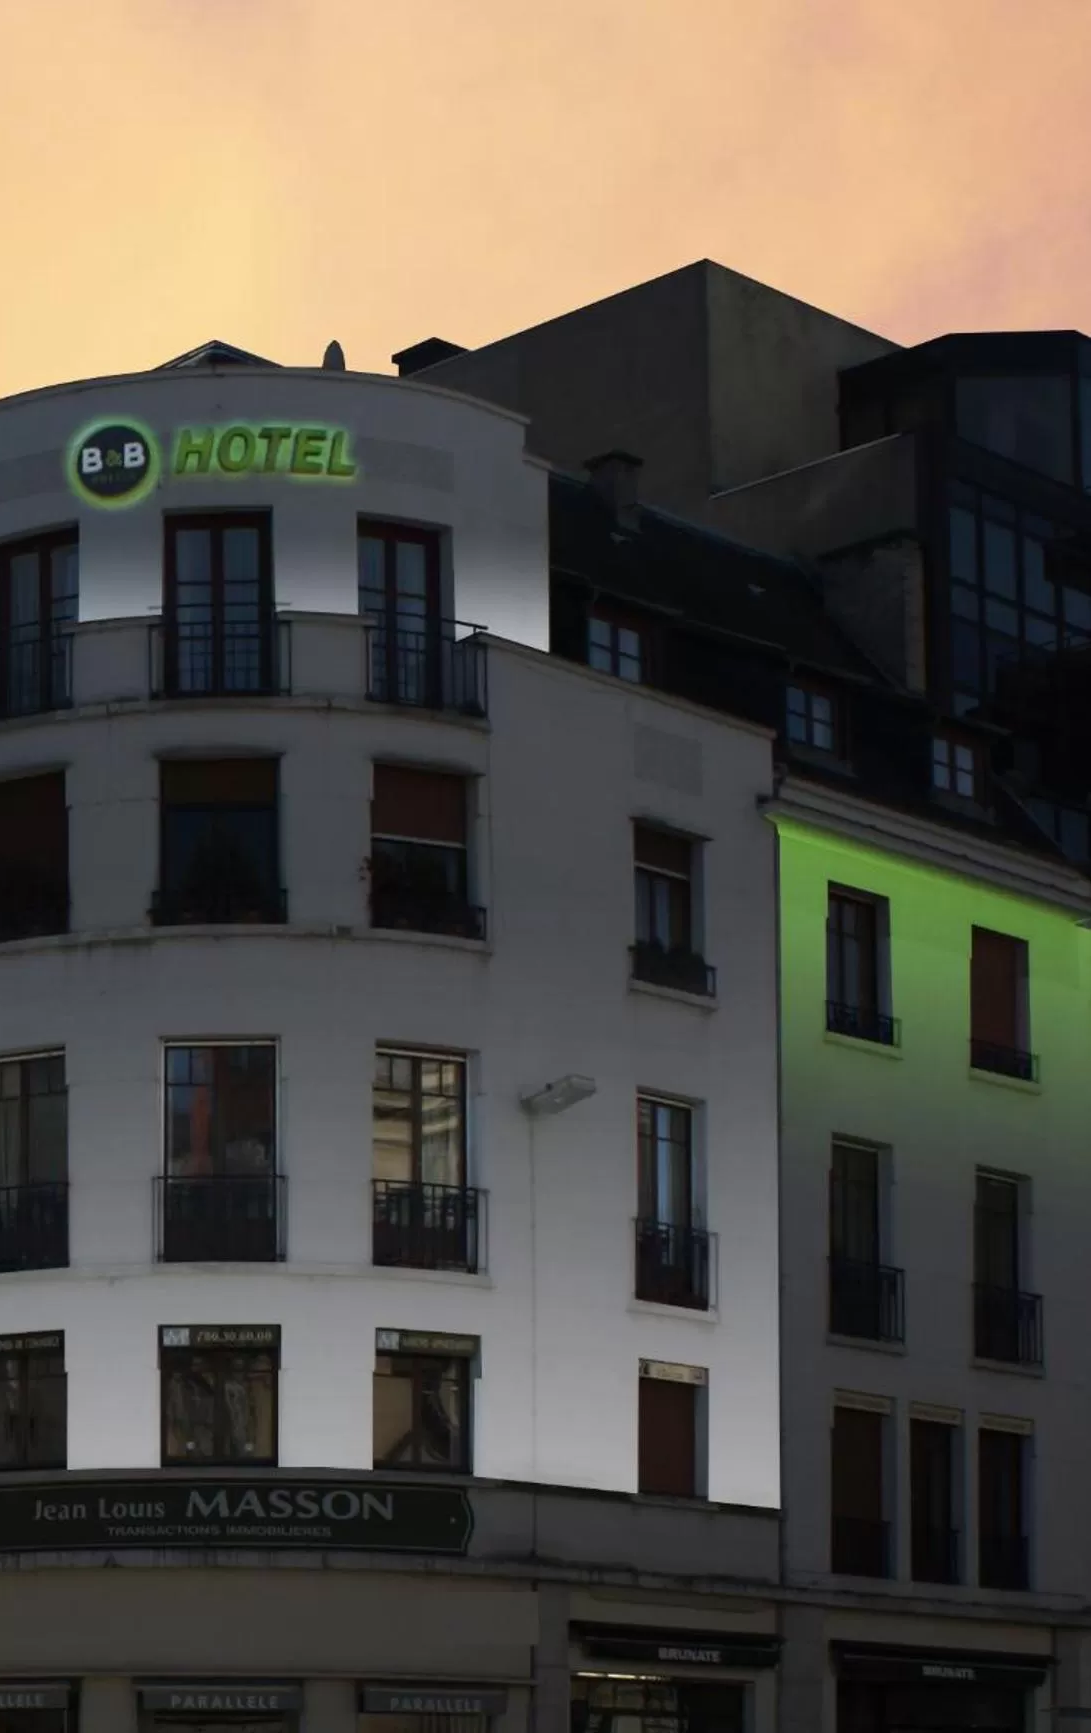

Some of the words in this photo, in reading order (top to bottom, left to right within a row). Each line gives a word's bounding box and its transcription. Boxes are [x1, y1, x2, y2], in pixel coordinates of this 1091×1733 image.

[82, 442, 145, 474] B&B
[175, 427, 357, 477] HOTEL
[33, 1498, 87, 1521] Jean
[98, 1497, 166, 1520] Louis
[185, 1488, 394, 1521] MASSON
[107, 1525, 221, 1537] TRANSACTIONS
[170, 1695, 279, 1709] PARALLELE
